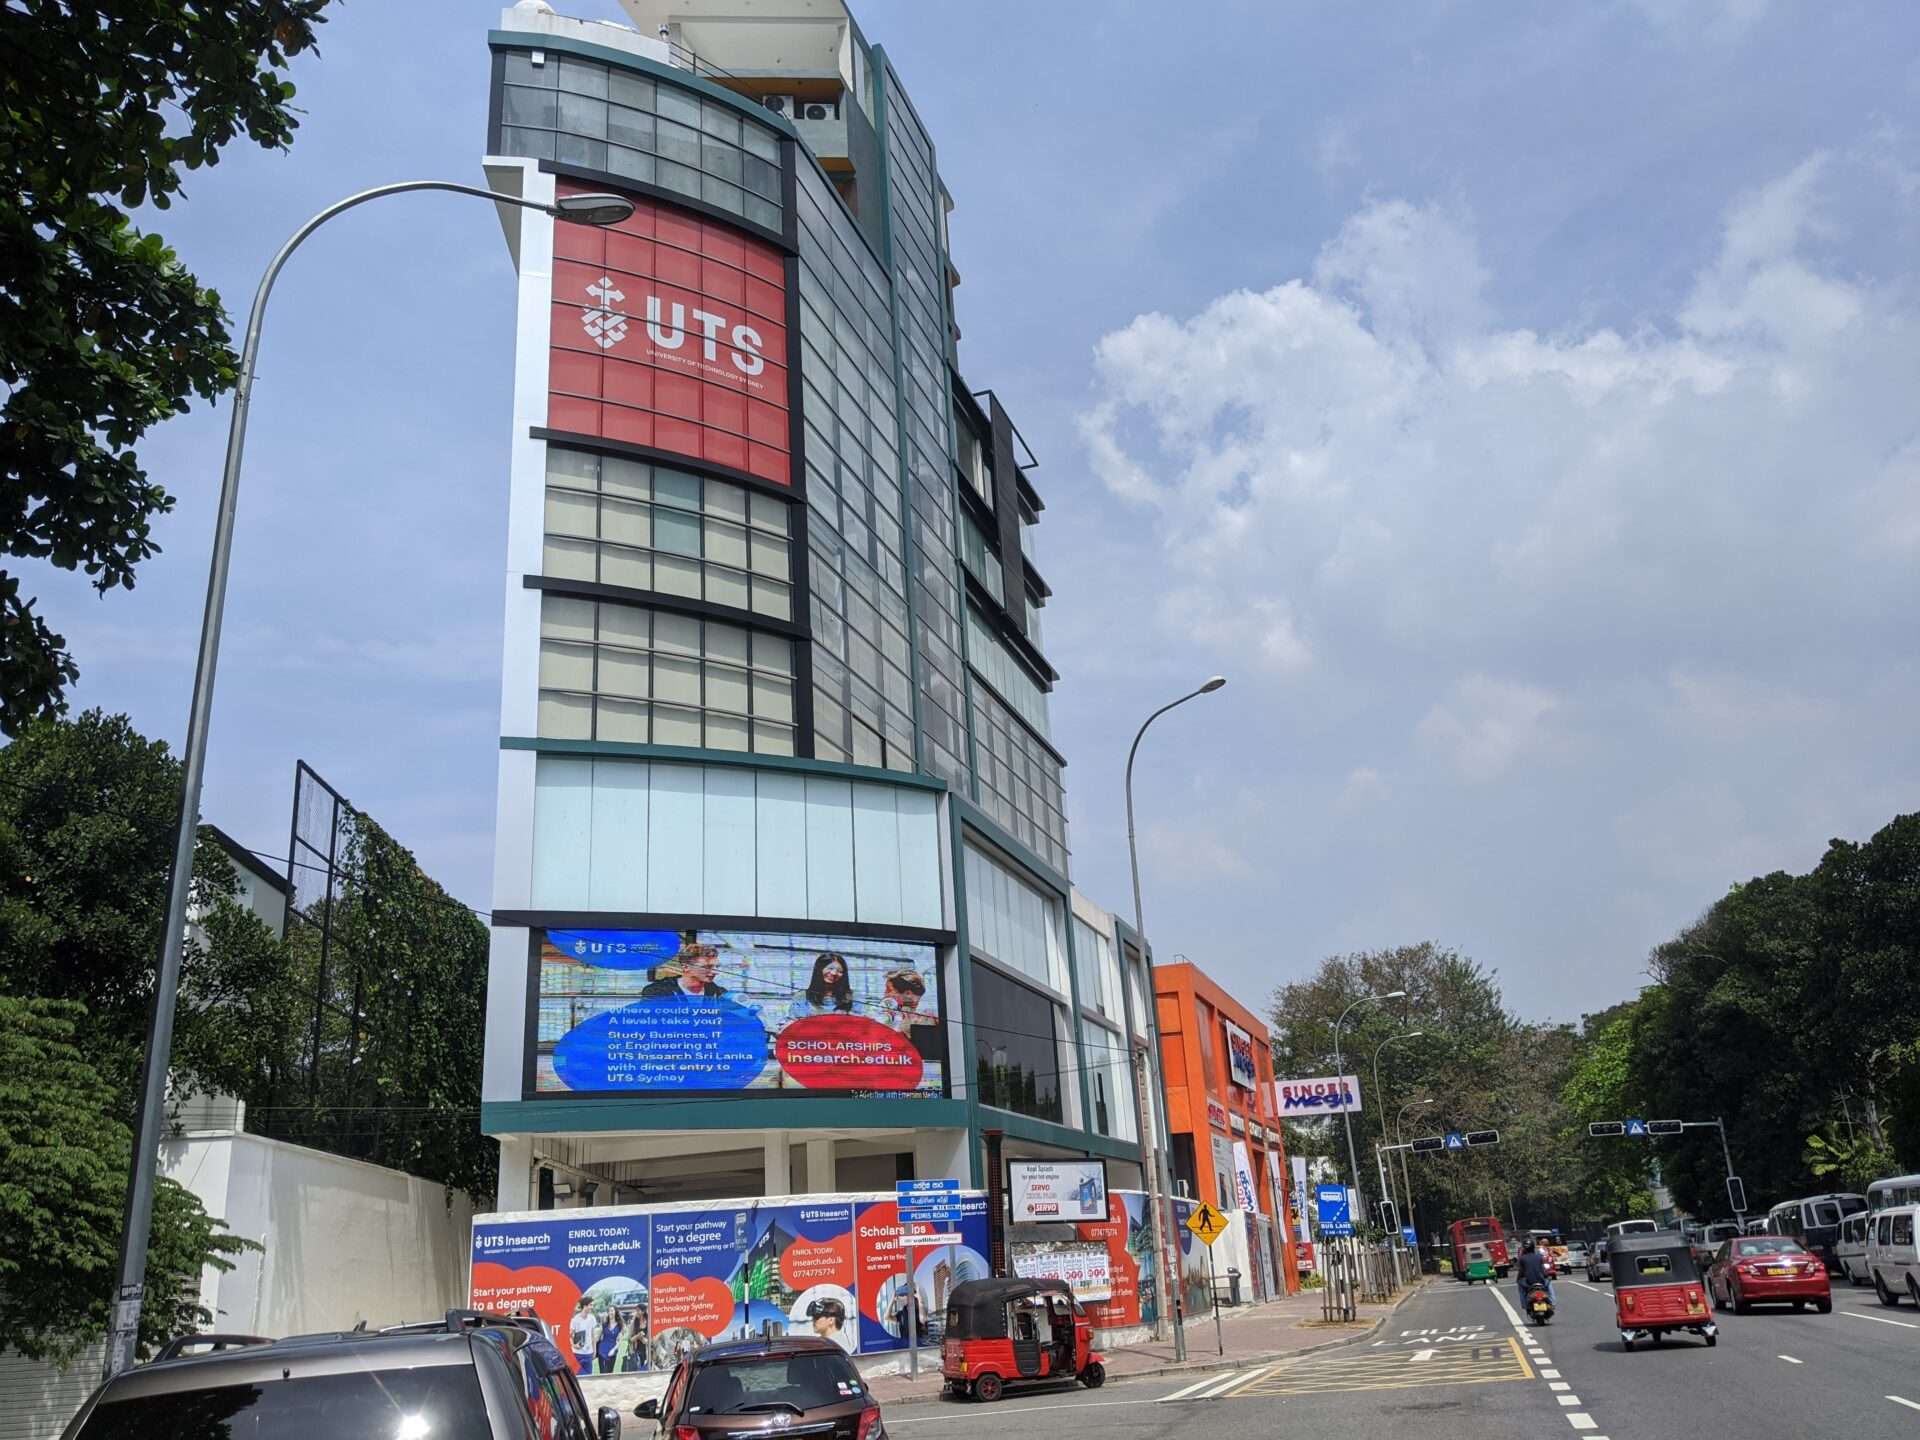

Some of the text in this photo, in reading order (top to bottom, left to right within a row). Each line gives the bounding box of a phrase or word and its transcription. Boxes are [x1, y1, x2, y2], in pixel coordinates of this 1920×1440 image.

[647, 296, 764, 376] UTS
[646, 348, 686, 363] UNIVERSITY
[697, 362, 739, 380] TECHNOLOGY
[739, 376, 764, 389] SYDNEY
[591, 943, 626, 953] UTS
[692, 1008, 720, 1016] your
[622, 1017, 658, 1025] levels
[662, 1017, 689, 1025] take
[693, 1018, 722, 1027] you?
[608, 1031, 646, 1040] Study
[650, 1032, 708, 1040] Business,
[625, 1042, 702, 1051] Engineering
[787, 1041, 892, 1051] SCHOLARSHIPS
[695, 1052, 713, 1060] Sri
[787, 1053, 913, 1065] insearch.edu.lk
[608, 1063, 636, 1071] with
[640, 1063, 676, 1071] direct
[679, 1064, 713, 1073] entry
[608, 1073, 685, 1083] UTS Sydney
[1282, 1082, 1349, 1098] SINGER
[1284, 1091, 1353, 1109] Mega
[1035, 1203, 1057, 1212] SERVO
[806, 1210, 818, 1218] UTS
[656, 1220, 727, 1233] Start your pathway
[860, 1224, 926, 1237] Scholarsips
[568, 1227, 630, 1239] ENROL TODAY:
[664, 1235, 675, 1244] to
[686, 1232, 721, 1244] degree
[484, 1232, 551, 1247] UTS Insearch
[689, 1243, 722, 1254] engineering
[567, 1255, 626, 1269] 0774775774
[656, 1255, 702, 1268] right here
[793, 1269, 835, 1279] 0774775774
[473, 1285, 552, 1297] Start your pathway
[666, 1295, 697, 1303] University
[698, 1292, 705, 1300] of
[473, 1298, 534, 1311] to a degree
[654, 1302, 714, 1313] Technology Sydney
[672, 1315, 689, 1323] heart
[690, 1314, 697, 1322] of
[698, 1313, 720, 1322] Sydney
[551, 1324, 561, 1336] IT
[1400, 1324, 1486, 1337] BUS
